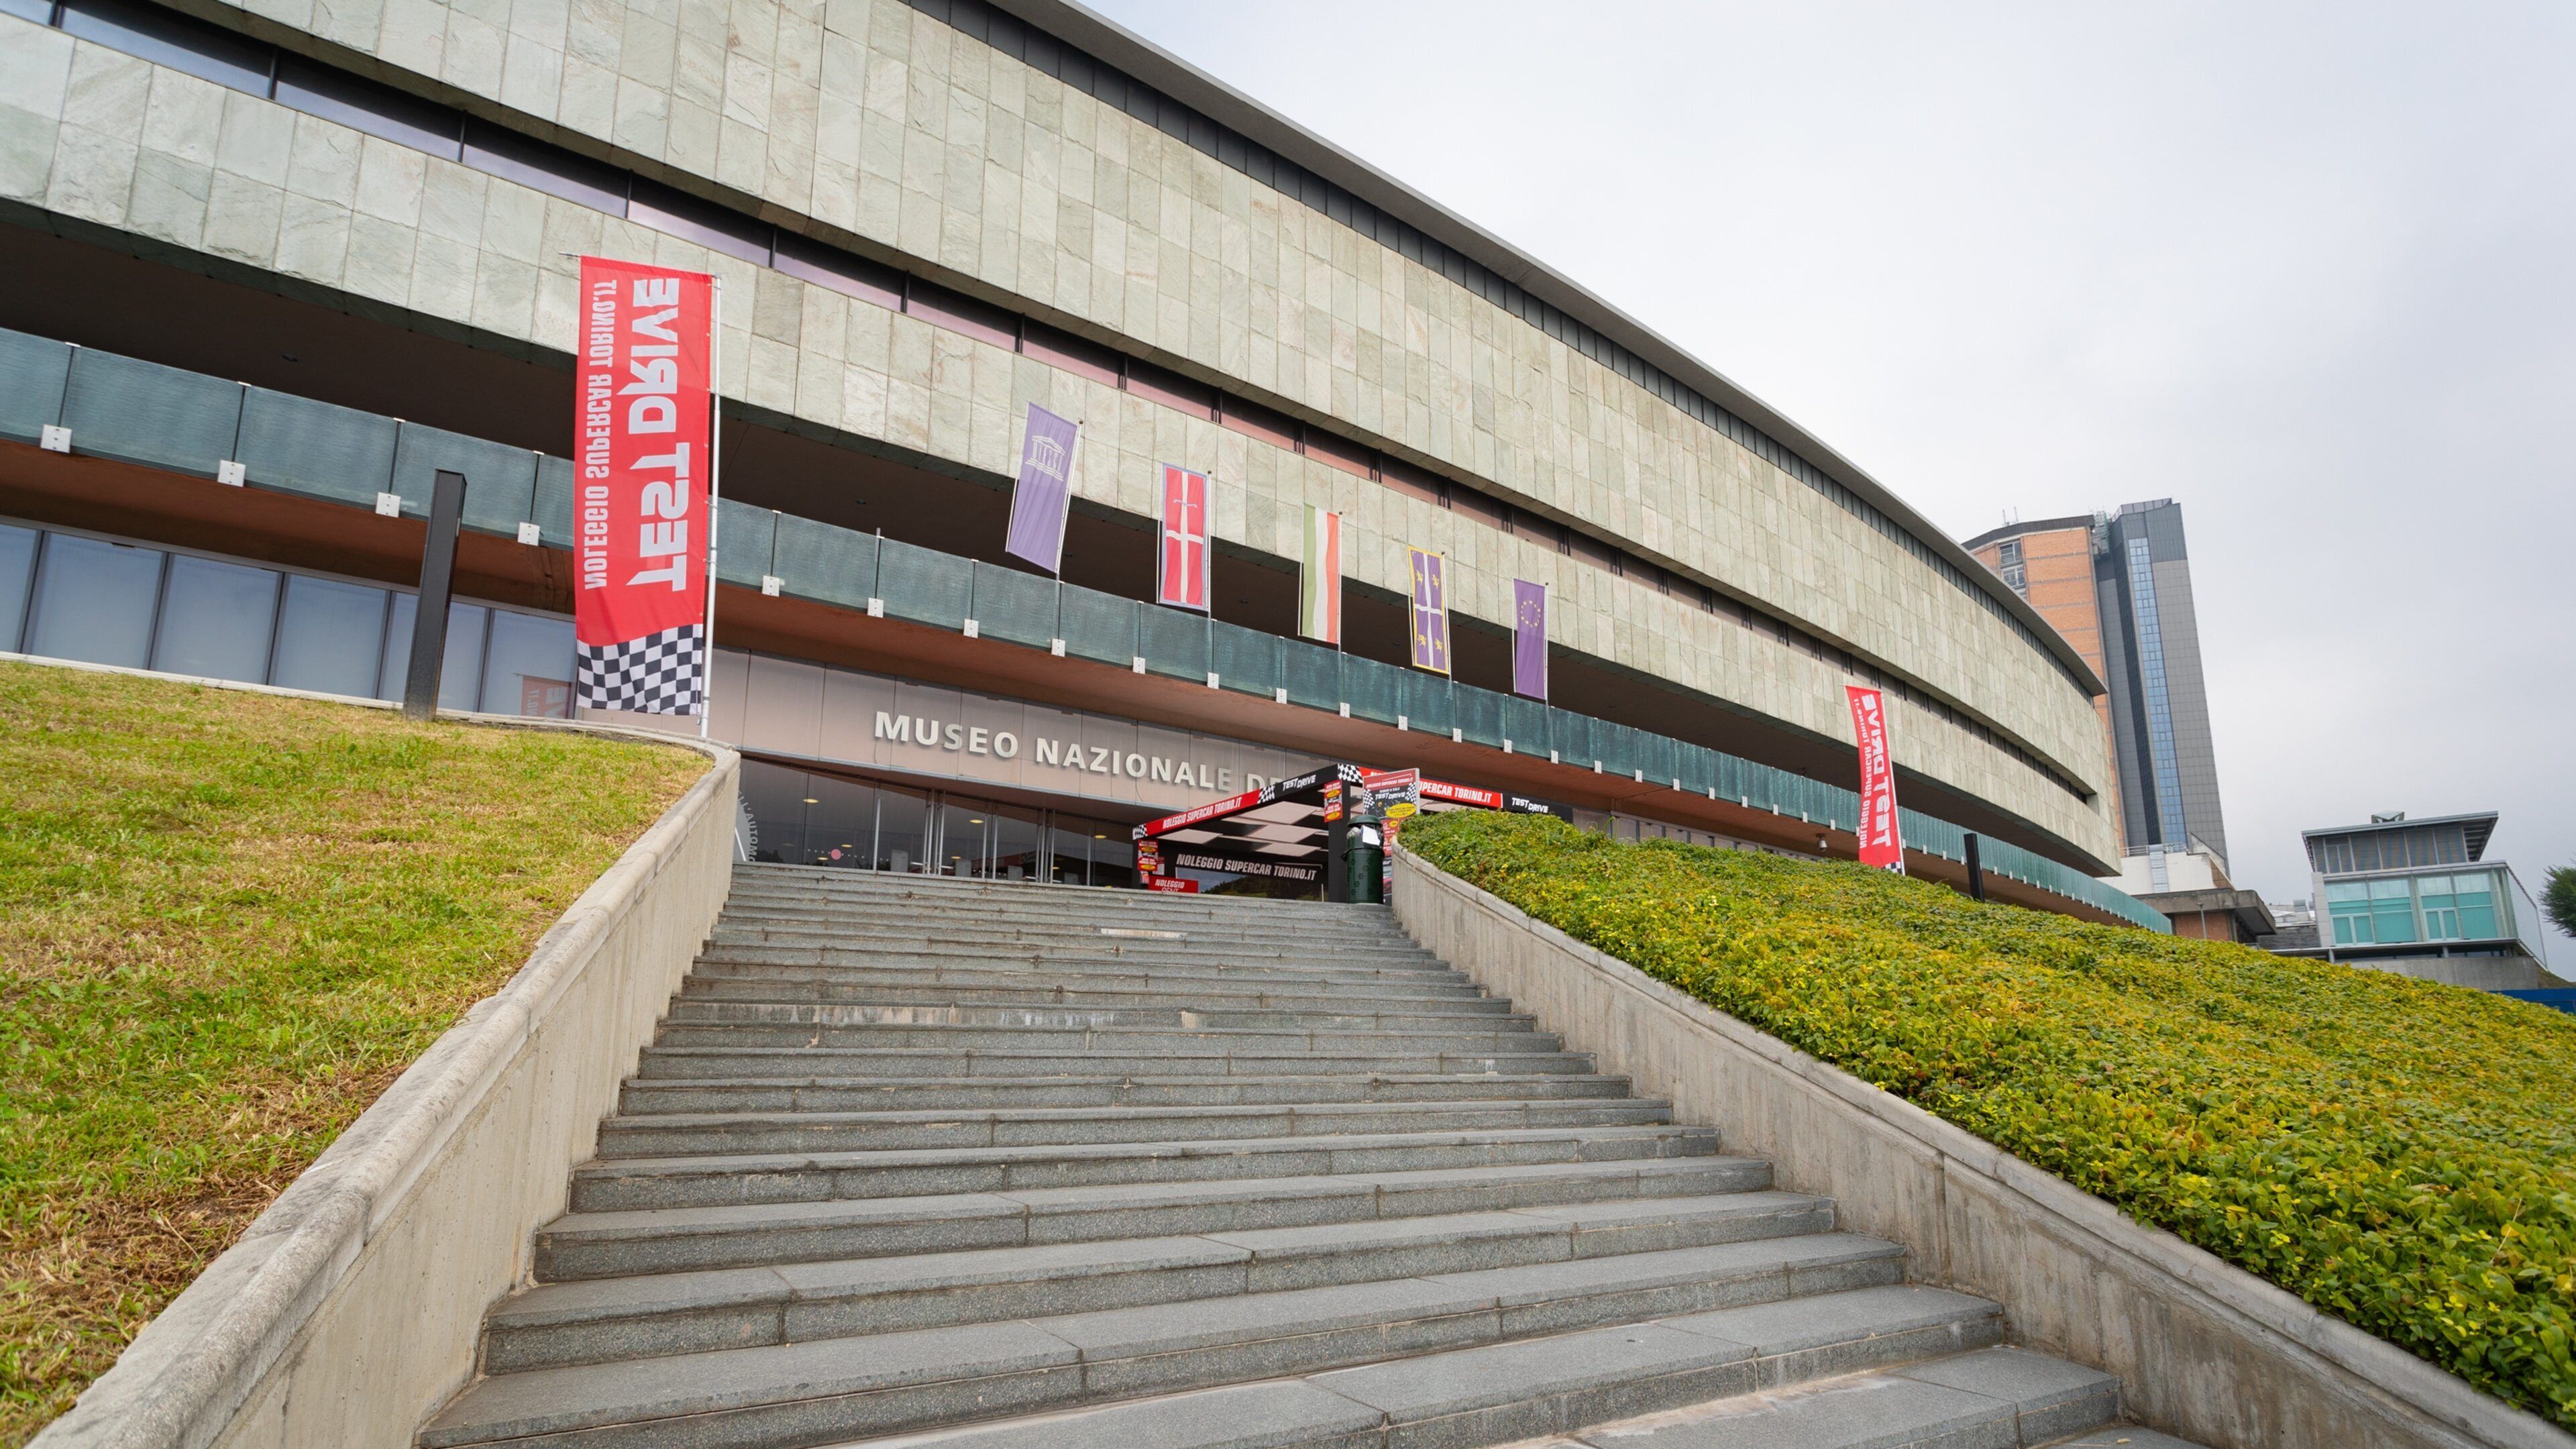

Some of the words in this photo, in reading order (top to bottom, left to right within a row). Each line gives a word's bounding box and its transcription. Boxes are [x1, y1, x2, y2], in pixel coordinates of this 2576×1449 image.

[874, 711, 1018, 759] MUSEO
[1036, 737, 1233, 792] NAZIONALE
[1282, 777, 1299, 792] TEST
[1297, 775, 1317, 789] DRIVE
[1417, 780, 1453, 796] UPERCAR
[1454, 787, 1493, 804] TORINO.IT
[1163, 813, 1187, 829] NOLEGGIO
[1187, 806, 1214, 822] SUPERCAR
[1214, 797, 1242, 813] TORINO.IT
[1511, 797, 1530, 809] TEST
[1527, 802, 1549, 813] DRIVE
[1176, 853, 1223, 869] NOLEGGIO
[1225, 859, 1272, 875] SUPERCAR
[1273, 865, 1317, 881] TORINO.IT
[1155, 879, 1185, 889] NOLEGGIO
